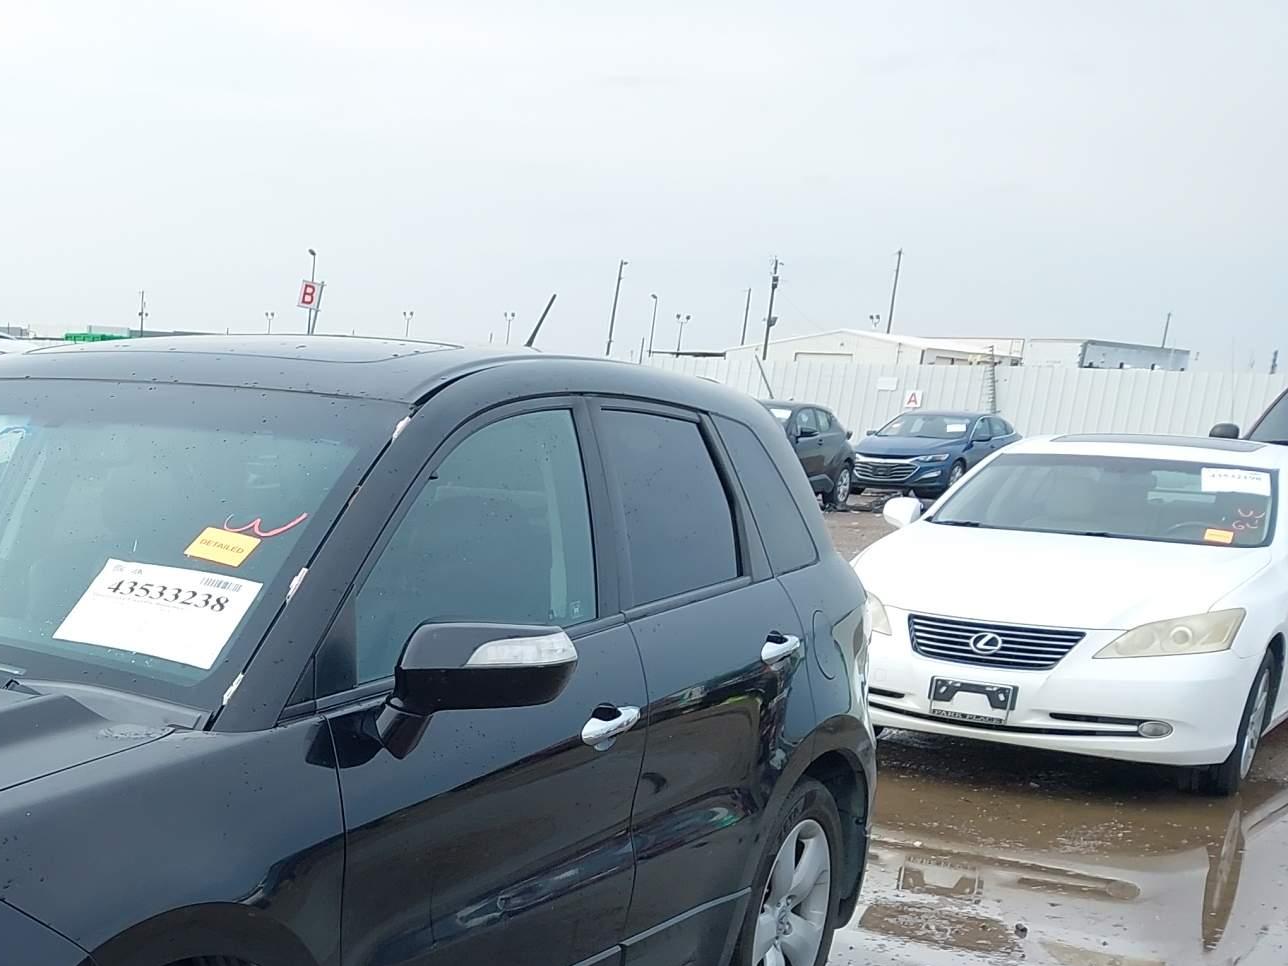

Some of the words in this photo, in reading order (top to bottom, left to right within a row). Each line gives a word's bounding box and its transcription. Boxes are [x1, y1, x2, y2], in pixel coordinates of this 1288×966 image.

[301, 283, 316, 305] B
[906, 392, 918, 406] A
[199, 538, 244, 554] DETAILED
[107, 579, 230, 613] 43533238
